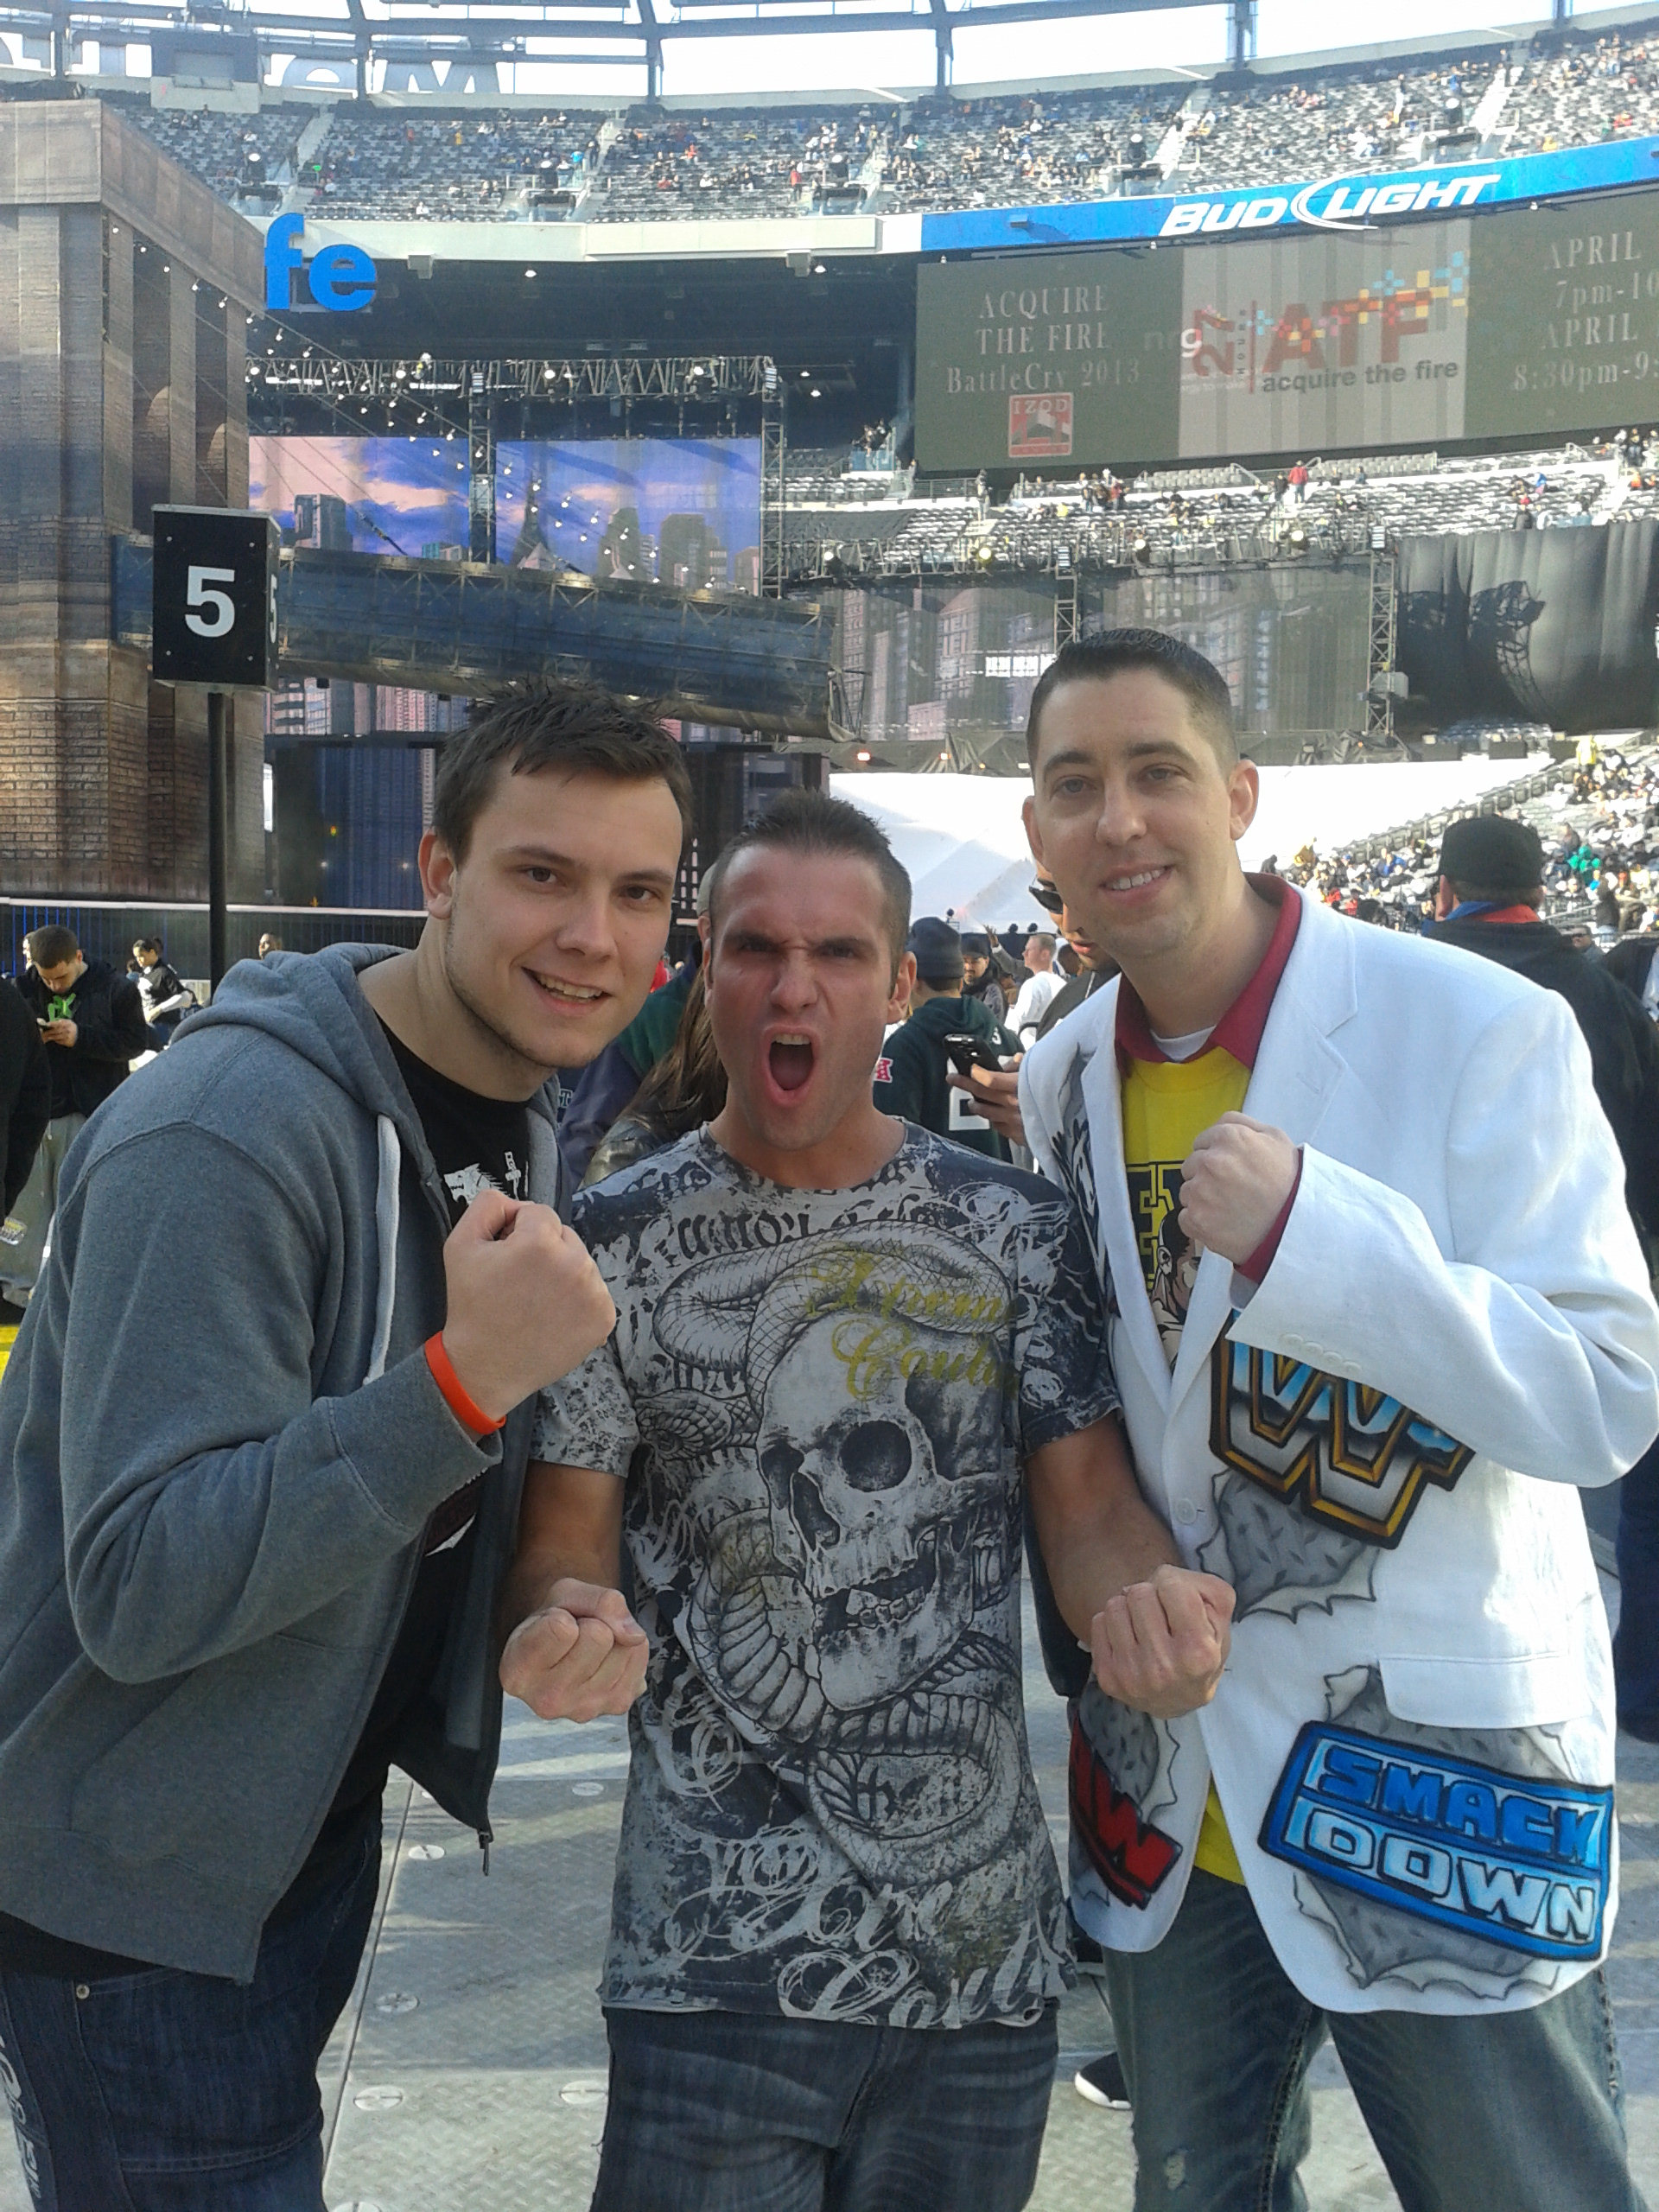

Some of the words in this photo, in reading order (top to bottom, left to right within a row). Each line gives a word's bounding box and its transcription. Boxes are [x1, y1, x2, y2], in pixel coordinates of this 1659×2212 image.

[1158, 196, 1288, 237] BUD
[1321, 174, 1502, 219] LIGHT
[1543, 231, 1641, 271] APRIL
[978, 285, 1109, 320] ACQUIRE
[976, 327, 1035, 355] THE
[1047, 322, 1109, 352] FIRE
[1262, 289, 1434, 374] ATF
[1541, 312, 1638, 349] APRIL
[946, 363, 1066, 394] BattleCry
[1081, 359, 1140, 387] 2013
[1262, 370, 1357, 394] acquire
[1365, 362, 1407, 385] the
[1415, 359, 1459, 380] fire
[1012, 399, 1070, 416] IZOD
[184, 564, 236, 638] 5
[1317, 1744, 1600, 1862] SMACK
[1303, 1807, 1596, 1942] DOWN
